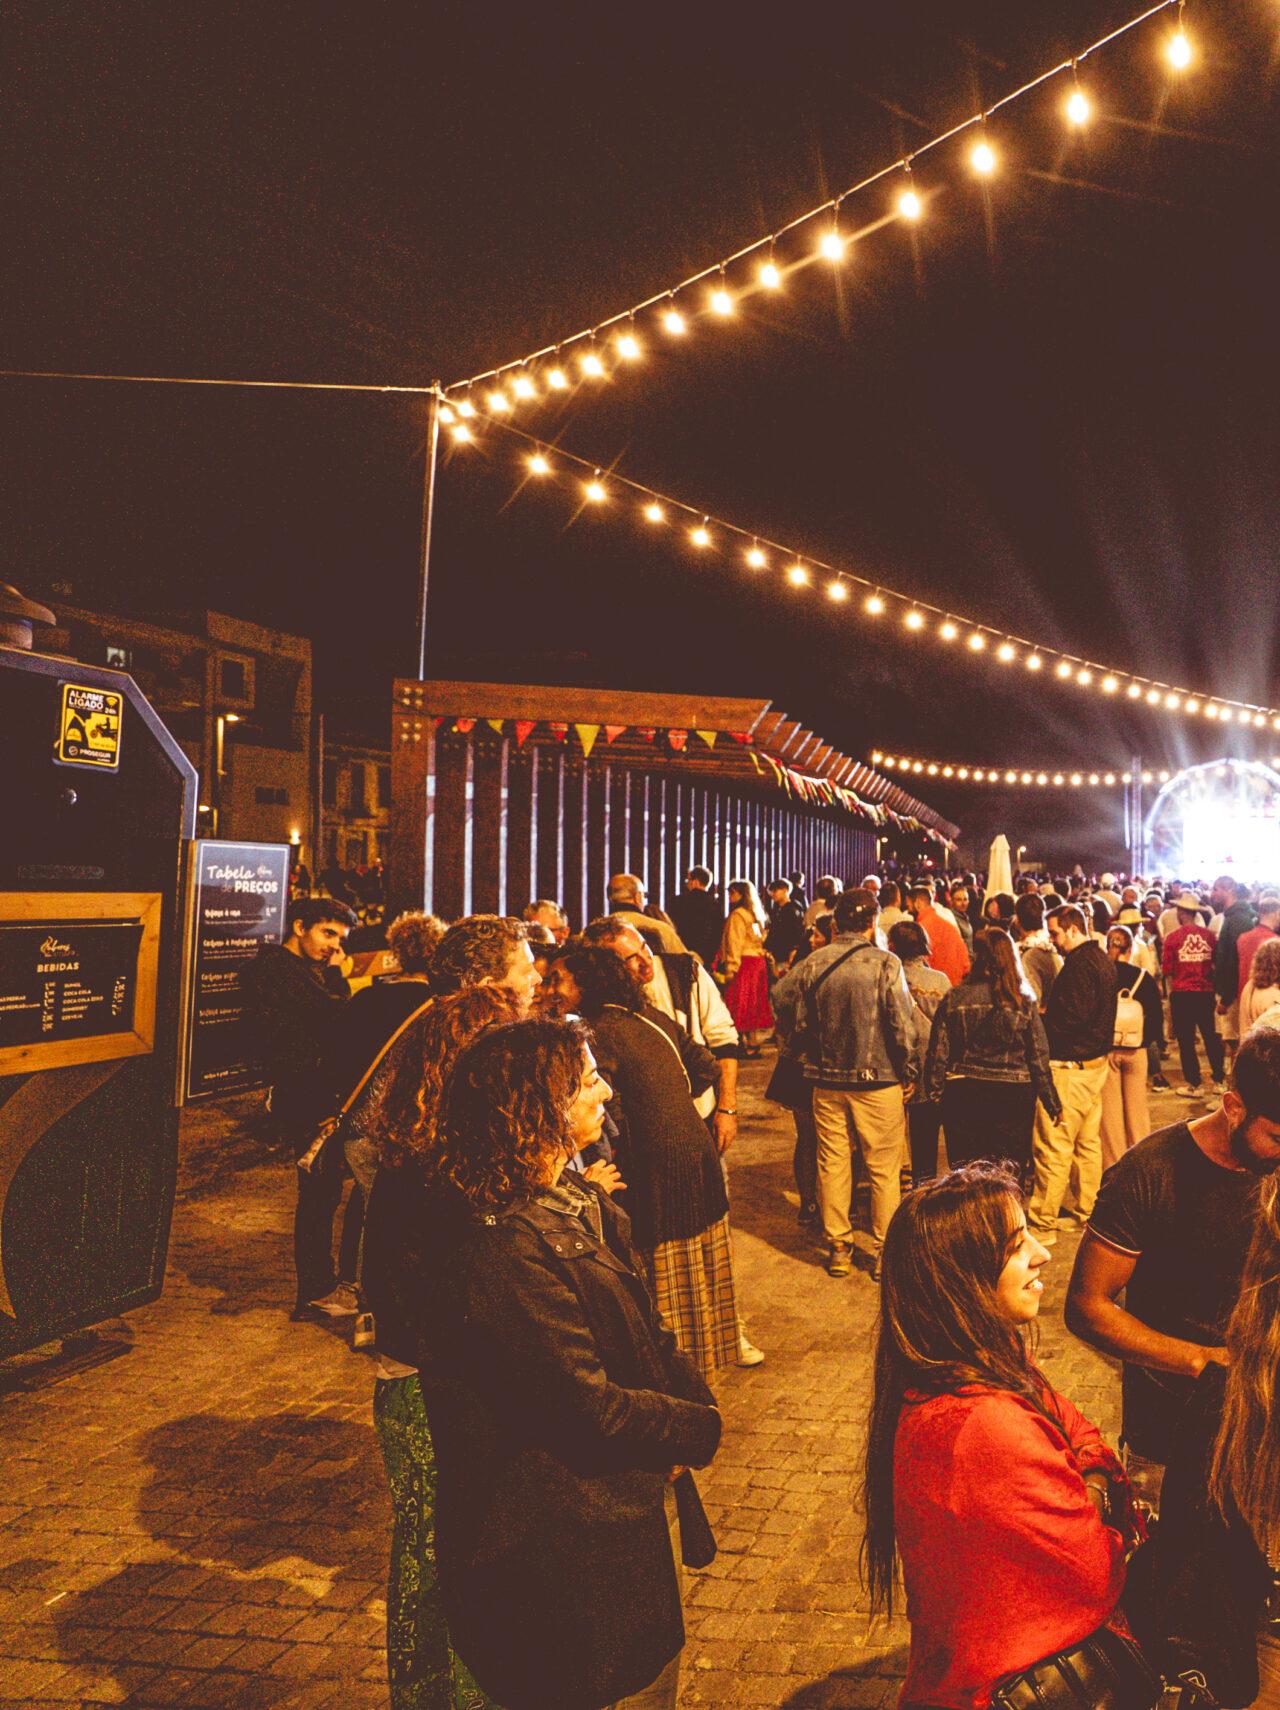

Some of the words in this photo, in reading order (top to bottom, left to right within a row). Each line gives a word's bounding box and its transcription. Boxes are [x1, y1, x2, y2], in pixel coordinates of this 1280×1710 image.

[70, 690, 104, 702] ALARME
[69, 697, 103, 709] LIGADO
[207, 865, 255, 880] Tabela
[234, 881, 278, 894] PREÇOS
[37, 962, 79, 973] BEBIDAS
